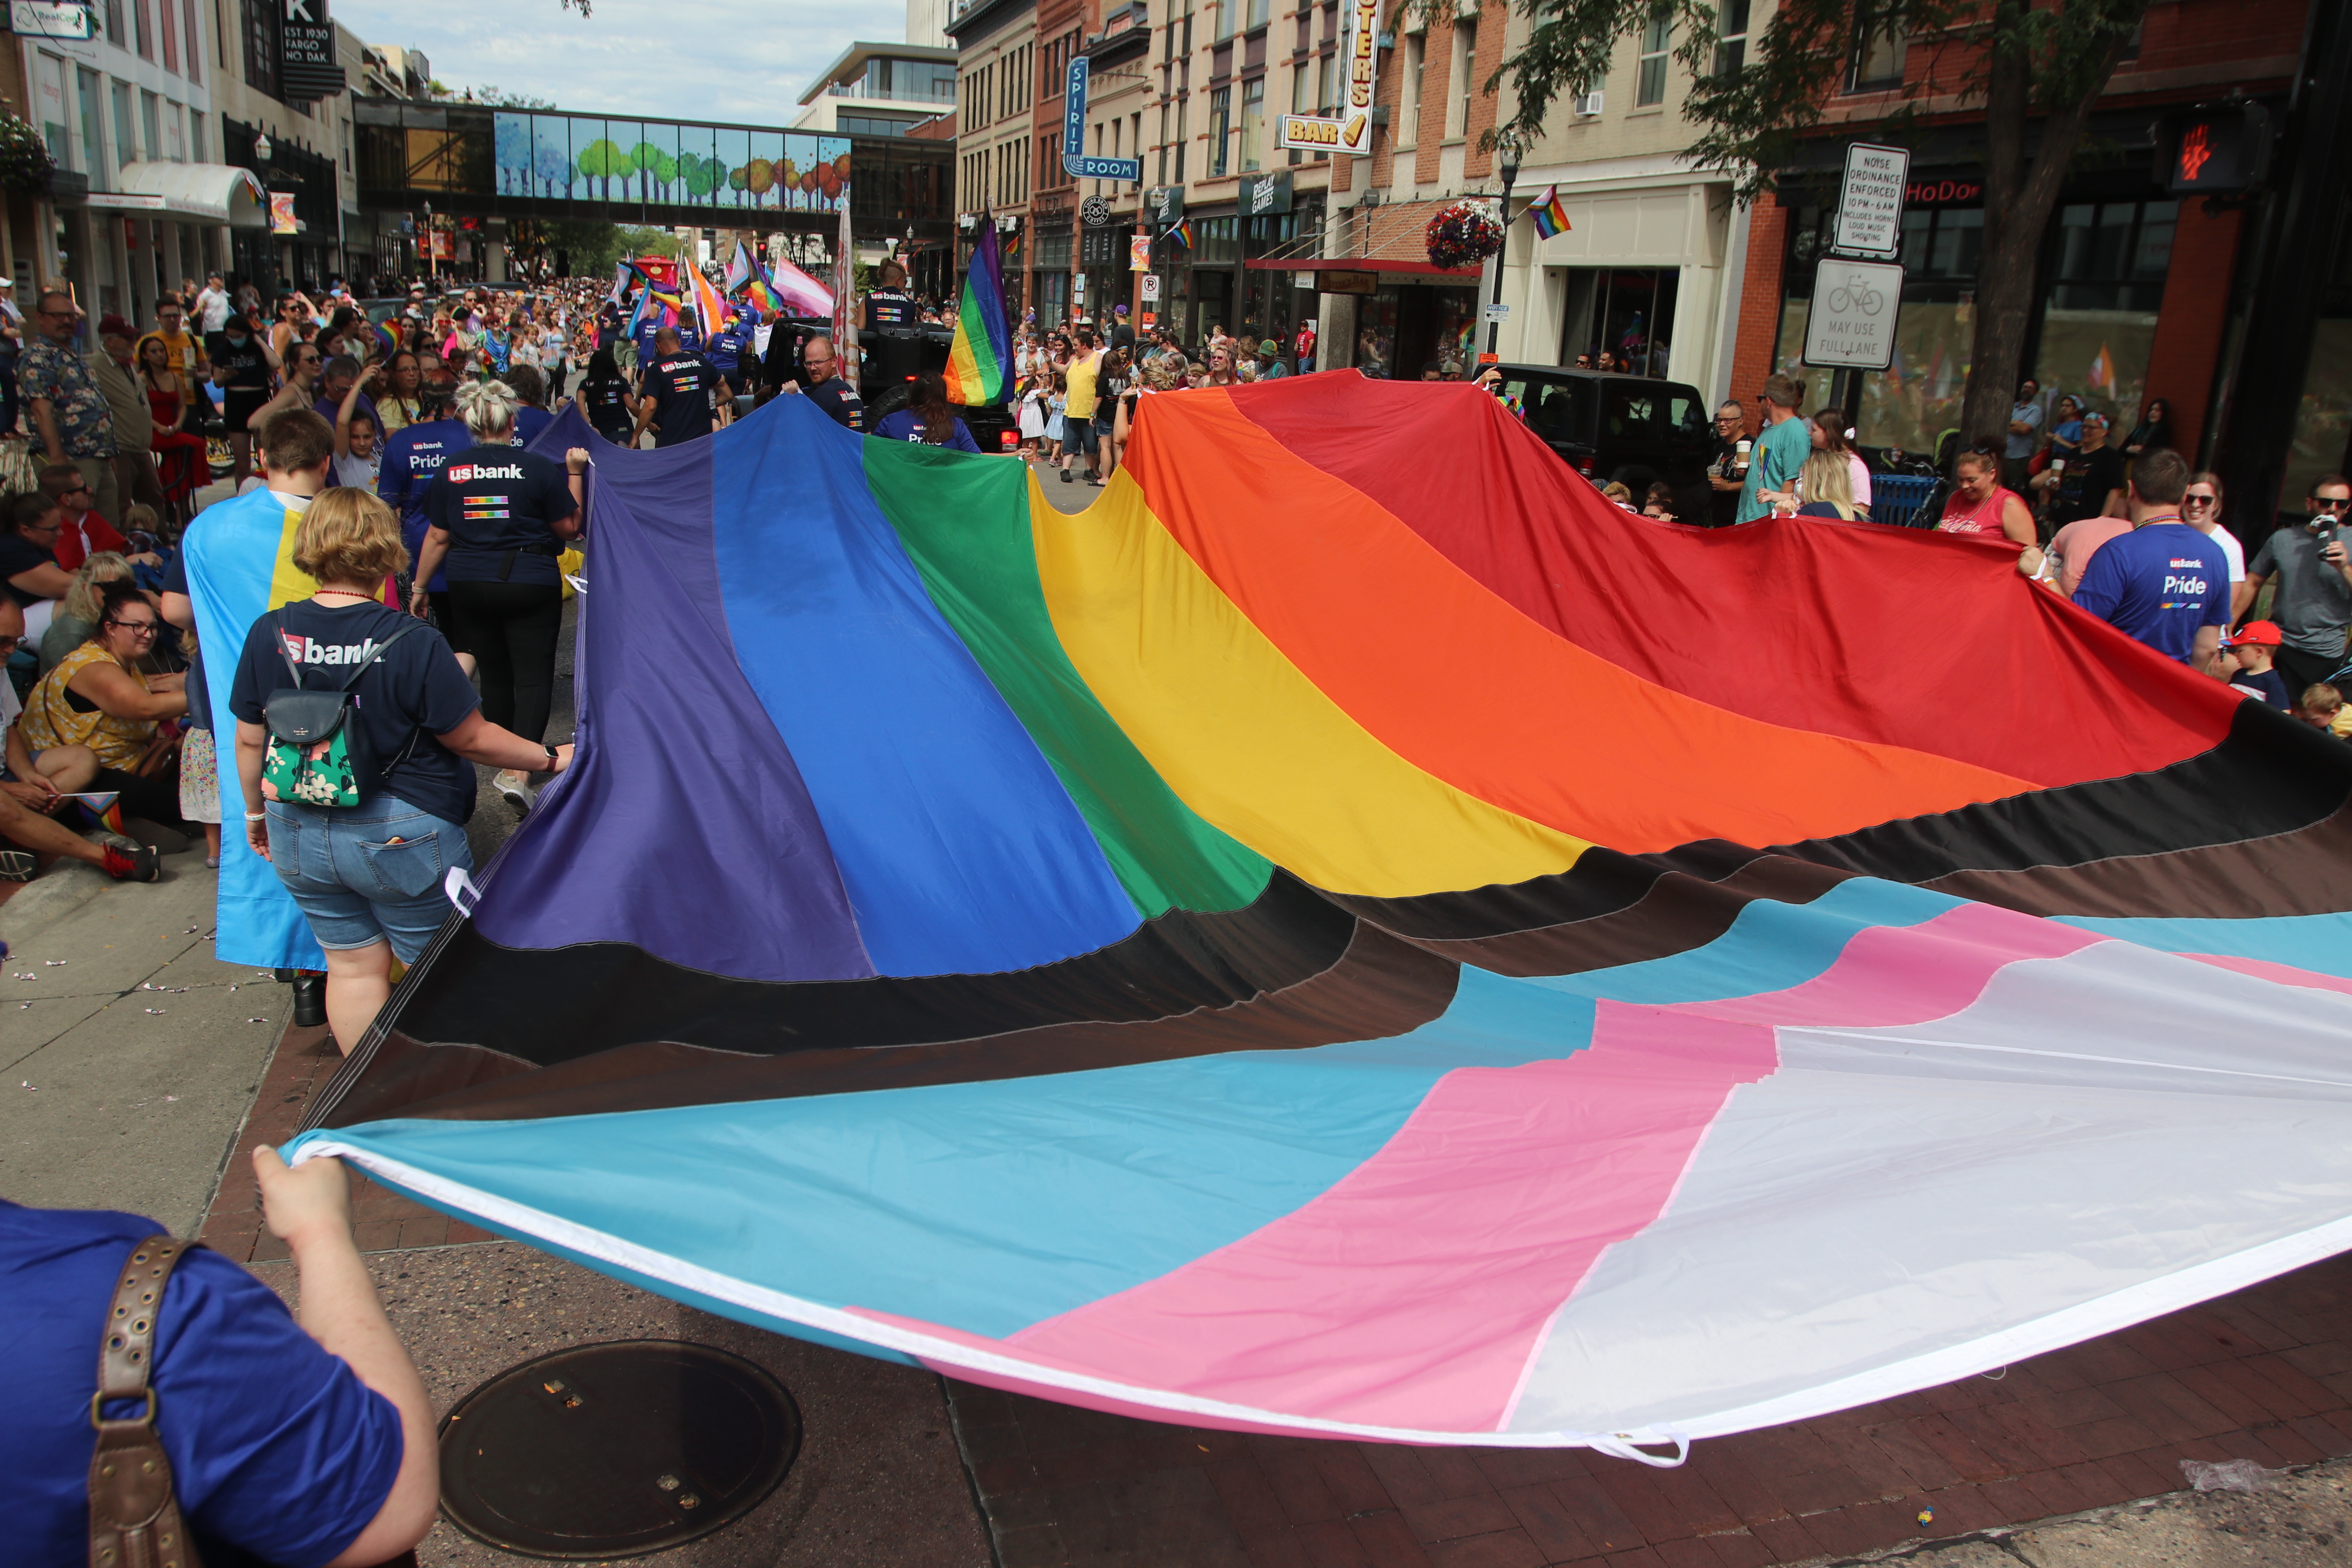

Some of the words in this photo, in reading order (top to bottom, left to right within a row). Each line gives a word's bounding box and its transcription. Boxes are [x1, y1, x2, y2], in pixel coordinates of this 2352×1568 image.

[285, 27, 303, 38] EST.
[306, 28, 328, 40] 1930
[286, 38, 319, 51] FARGO
[286, 51, 304, 61] NO.
[307, 51, 329, 63] DAK.
[1351, 0, 1376, 107] TERS
[1070, 67, 1082, 153] SPIRIT
[1288, 120, 1337, 145] BAR
[1087, 161, 1132, 176] ROOM
[1864, 156, 1891, 169] NOISE
[1850, 169, 1901, 185] ORDINANCE
[1253, 174, 1275, 201] REPLAY
[1850, 183, 1896, 198] ENFORCED
[1085, 198, 1096, 208] THIRD
[1097, 198, 1108, 210] DROP
[1252, 192, 1274, 214] GAMES
[1848, 198, 1856, 207] 10
[1858, 199, 1869, 209] PM
[1876, 201, 1881, 210] 6
[1158, 203, 1170, 220] MES
[1843, 211, 1871, 220] INCLUDES
[1874, 214, 1895, 223] HORNS
[1086, 214, 1105, 223] COFFEE
[1848, 221, 1865, 230] LOUD
[1867, 224, 1886, 232] MUSIC
[1851, 231, 1881, 241] SHOUTING
[1829, 321, 1851, 334] MAY
[1854, 322, 1876, 335] USE
[1820, 339, 1844, 352] FULL
[1849, 342, 1878, 355] LANE
[661, 360, 701, 373] usbank
[839, 391, 861, 401] usban
[413, 442, 443, 450] usbank
[450, 463, 524, 481] usbank
[2170, 558, 2203, 569] usbank
[2162, 576, 2207, 594] Pride
[283, 633, 382, 665] sbank
